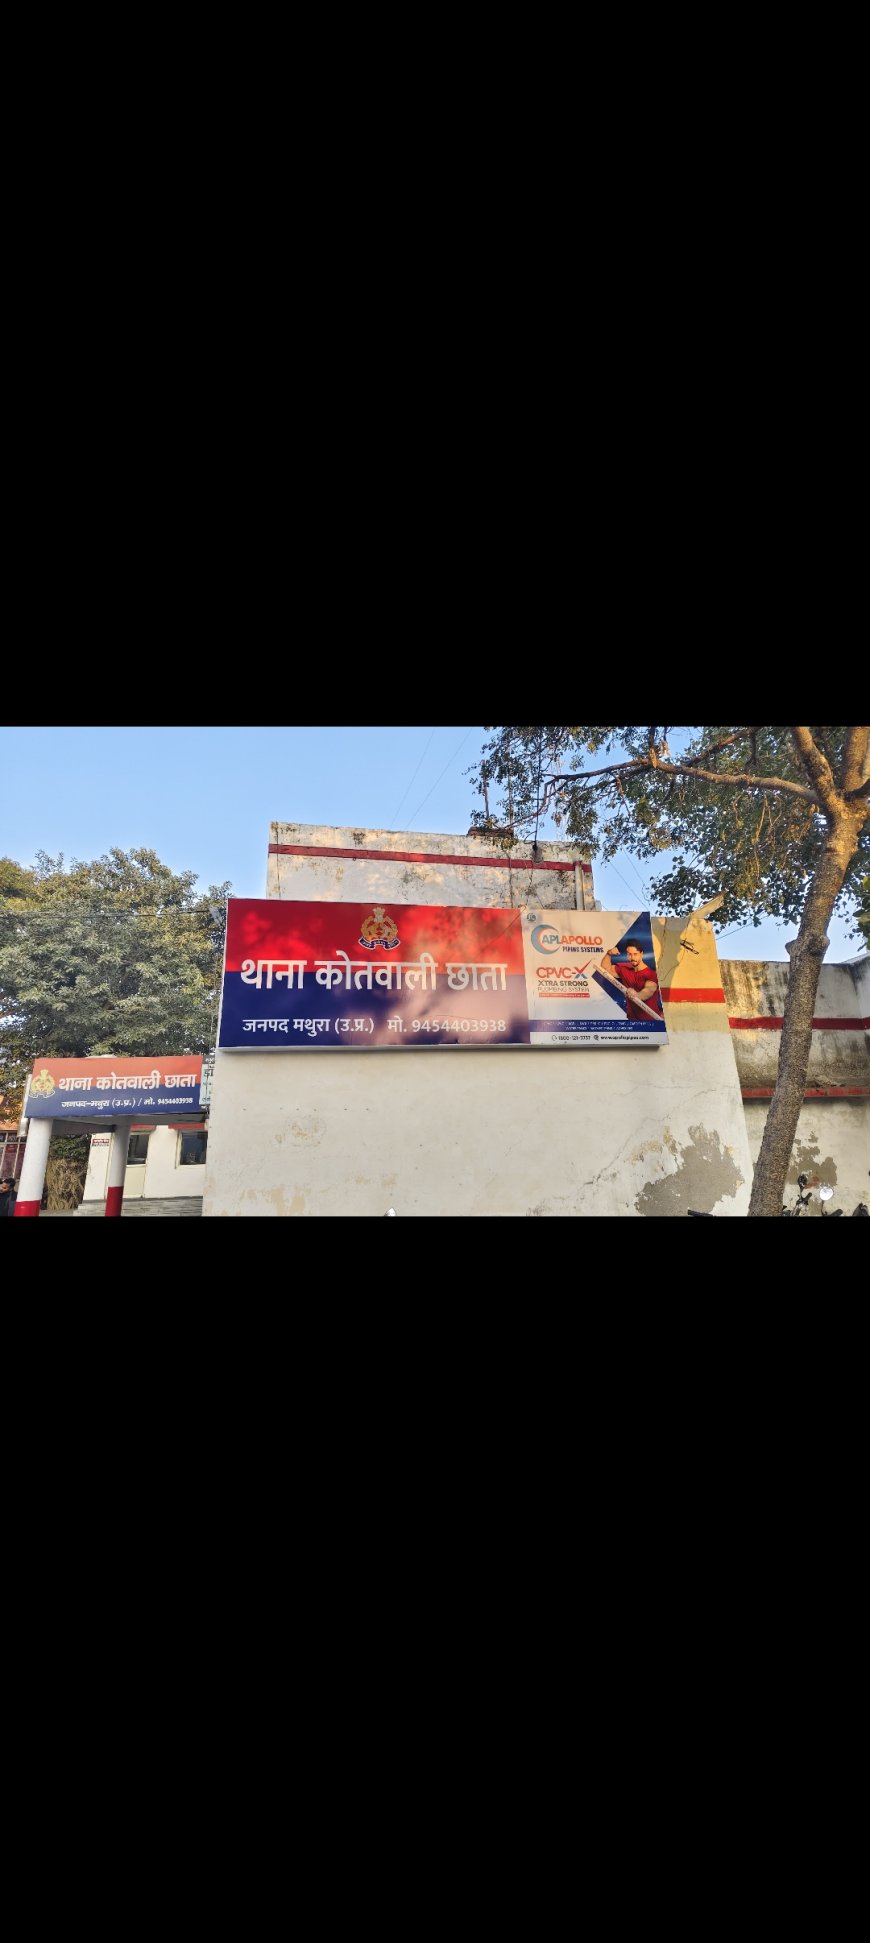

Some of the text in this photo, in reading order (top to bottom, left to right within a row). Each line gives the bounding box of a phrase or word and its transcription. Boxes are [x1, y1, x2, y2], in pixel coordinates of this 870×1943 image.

[240, 950, 508, 991] थाना कोतवाली छाता
[242, 1016, 507, 1037] जनपद मथुरा (उ.प्र.) मो. 9454403938
[58, 1070, 197, 1091] थाना कोतवाली छाता
